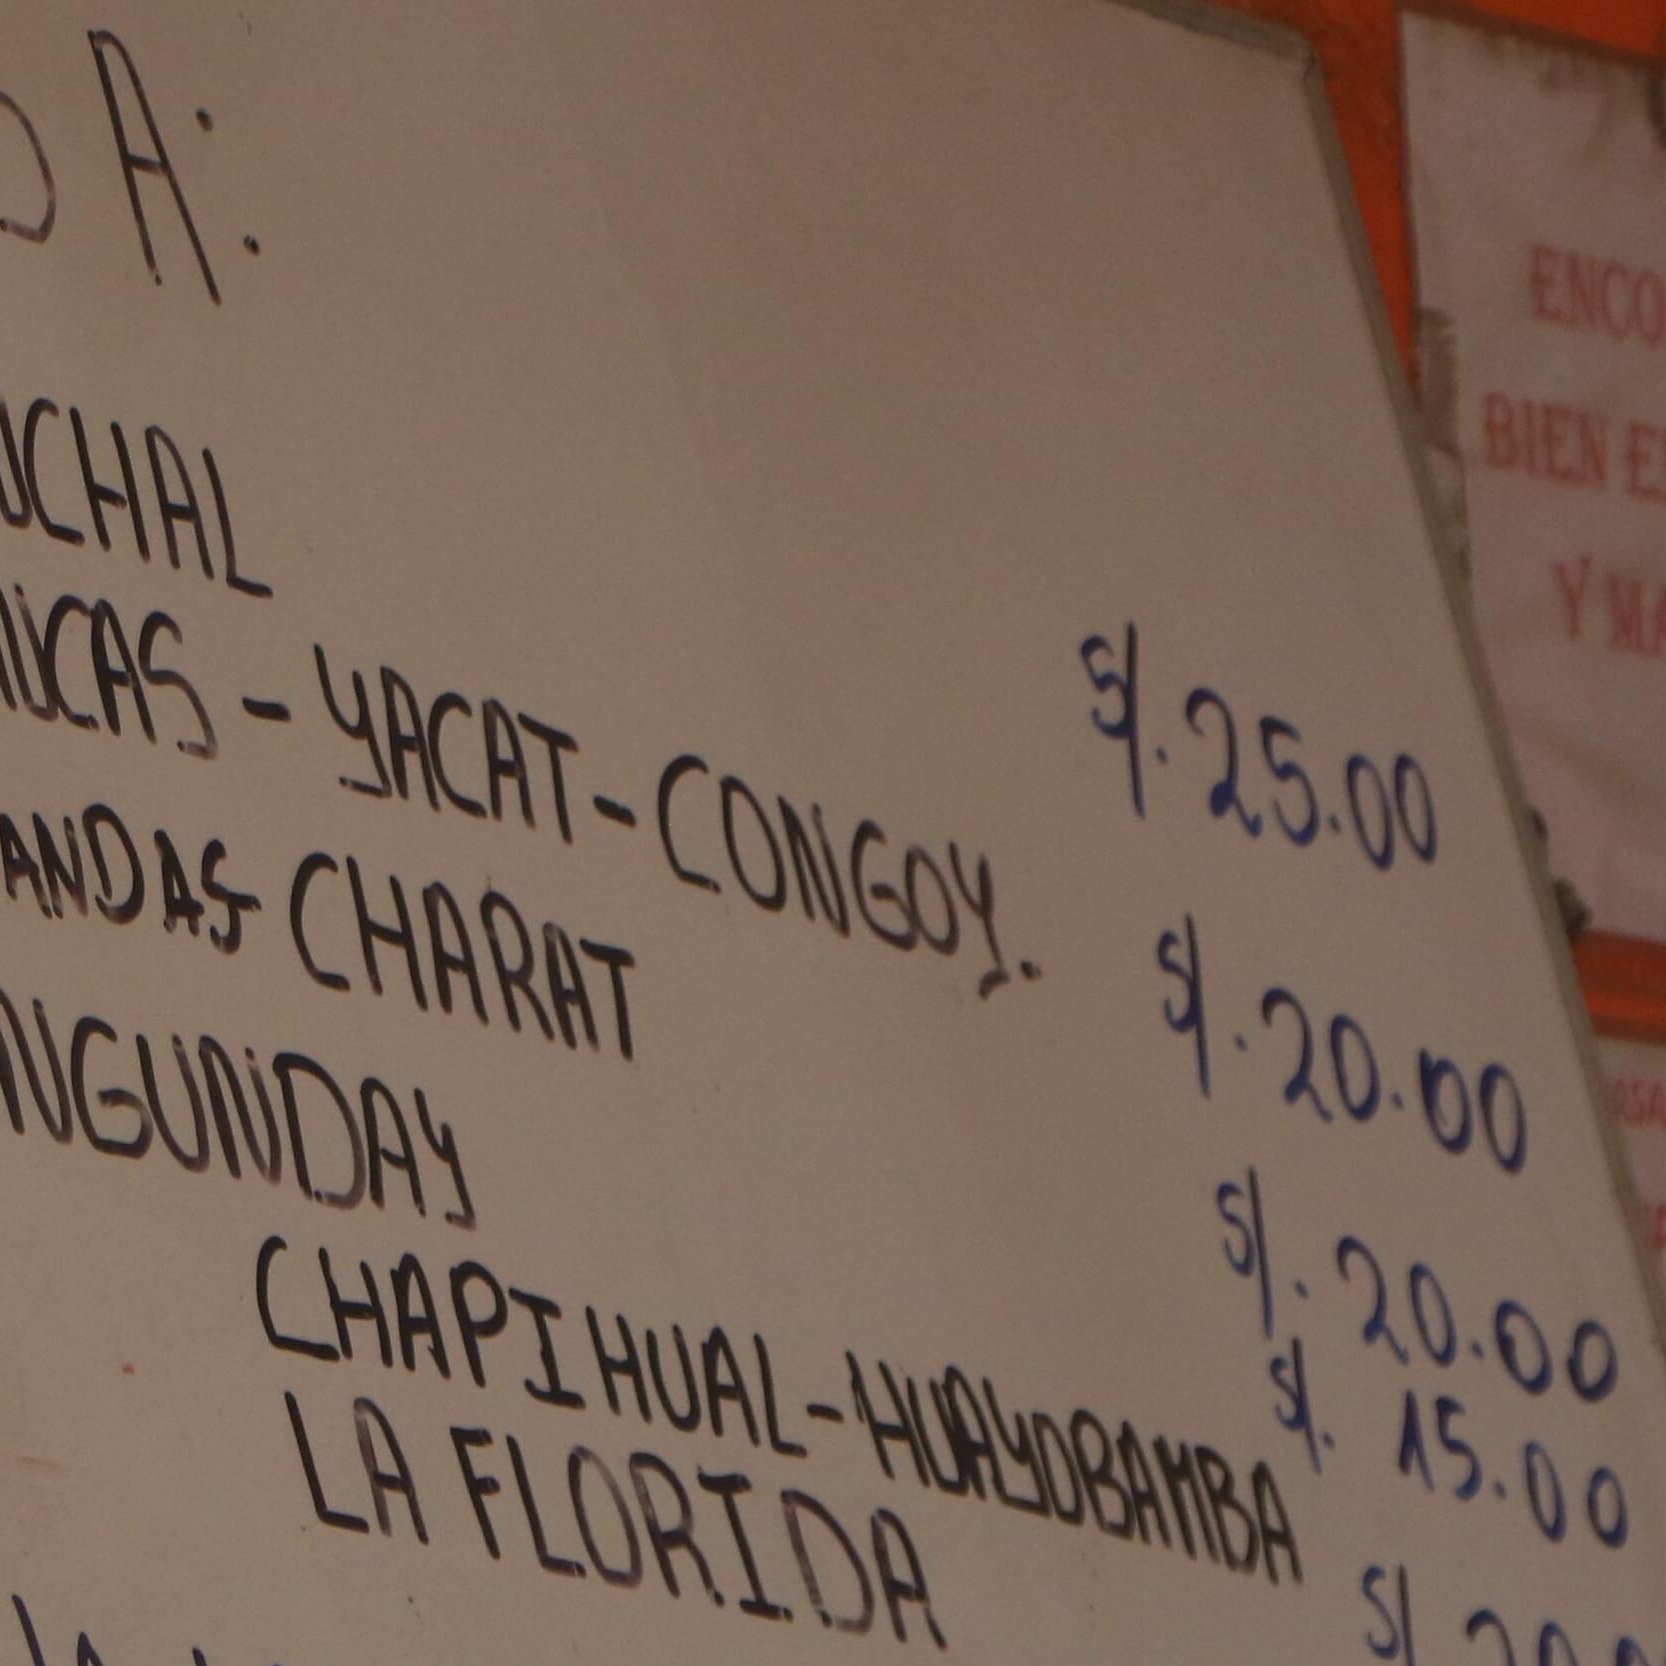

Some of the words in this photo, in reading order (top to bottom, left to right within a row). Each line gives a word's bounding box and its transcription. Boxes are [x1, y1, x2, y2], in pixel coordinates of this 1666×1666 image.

[1479, 390, 1610, 490] BIEN
[1548, 552, 1595, 643] Y
[281, 1389, 430, 1547] LA
[448, 1424, 950, 1653] FLORIDA
